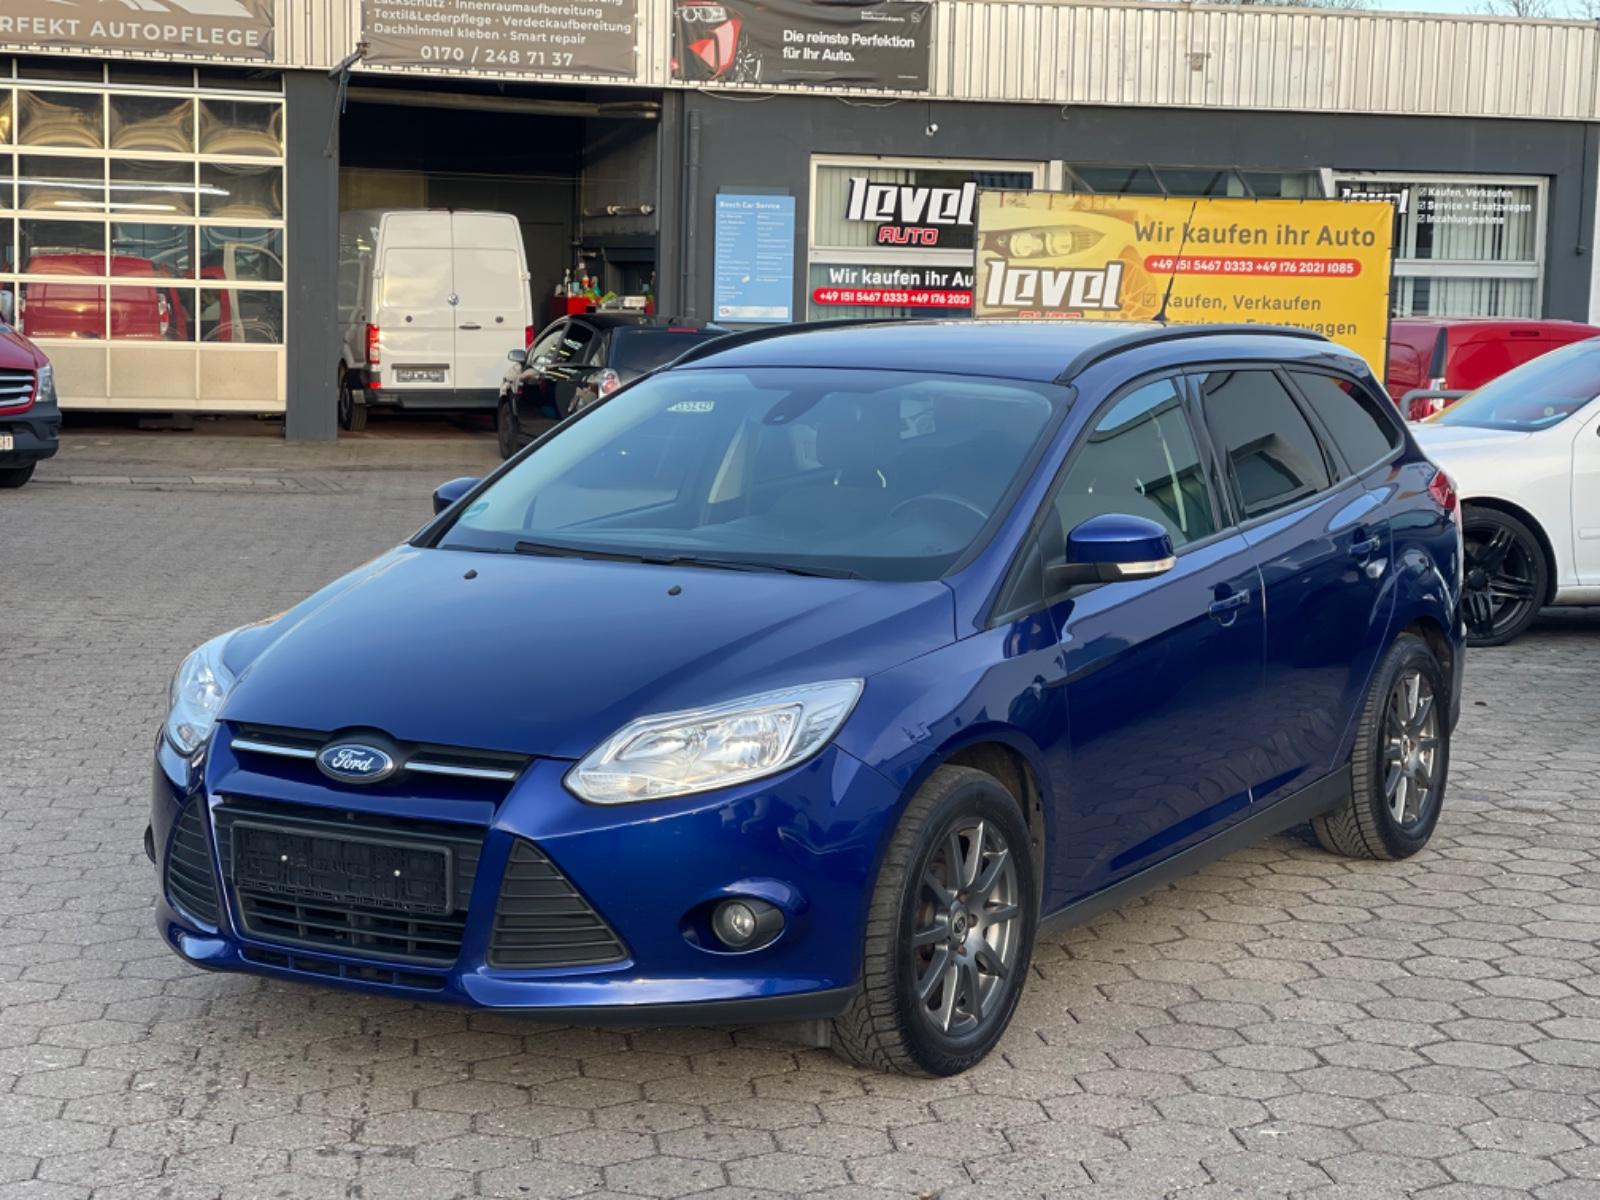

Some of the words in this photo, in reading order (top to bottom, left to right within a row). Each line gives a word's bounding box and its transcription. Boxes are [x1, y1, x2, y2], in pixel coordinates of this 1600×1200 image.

[374, 8, 492, 27] Textil&Lederpflege
[502, 16, 631, 34] Verdeckaufbereitung
[90, 20, 260, 47] AUTOPFLEGE
[374, 23, 454, 37] Dachhimmel
[457, 27, 500, 40] kleben
[510, 30, 547, 43] Smart
[549, 33, 587, 46] repair
[783, 29, 805, 43] Die
[806, 31, 850, 45] reinste
[851, 33, 915, 48] Perfektion
[420, 45, 465, 62] 0170
[470, 47, 479, 63] /
[485, 48, 520, 64] 248
[529, 50, 546, 65] 71
[552, 51, 574, 67] 37
[782, 46, 801, 59] für
[803, 47, 820, 60] Ihr
[821, 48, 855, 62] Auto.
[848, 176, 977, 225] level
[878, 226, 939, 245] AUTO
[1134, 220, 1175, 242] Wir
[1183, 221, 1268, 245] kaufen
[1276, 224, 1310, 246] ihr
[1316, 225, 1376, 247] Auto
[829, 268, 856, 284] Wir
[862, 268, 920, 286] kaufen
[925, 270, 949, 286] ihr
[1152, 258, 1174, 269] +49
[1193, 259, 1221, 271] 5467
[1224, 260, 1253, 272] 0333
[1256, 261, 1277, 273] +49
[1279, 262, 1297, 273] 176
[1299, 262, 1325, 274] 2021
[1327, 263, 1355, 275] 1085
[985, 259, 1122, 309] level
[820, 291, 839, 301] +49
[840, 291, 854, 301] 151
[856, 291, 881, 302] 5467
[882, 291, 909, 303] 0333
[911, 293, 929, 303] +49
[930, 293, 946, 304] 176
[947, 293, 970, 304] 2021
[1232, 294, 1321, 311] Verkaufen
[331, 748, 375, 772] Ford
